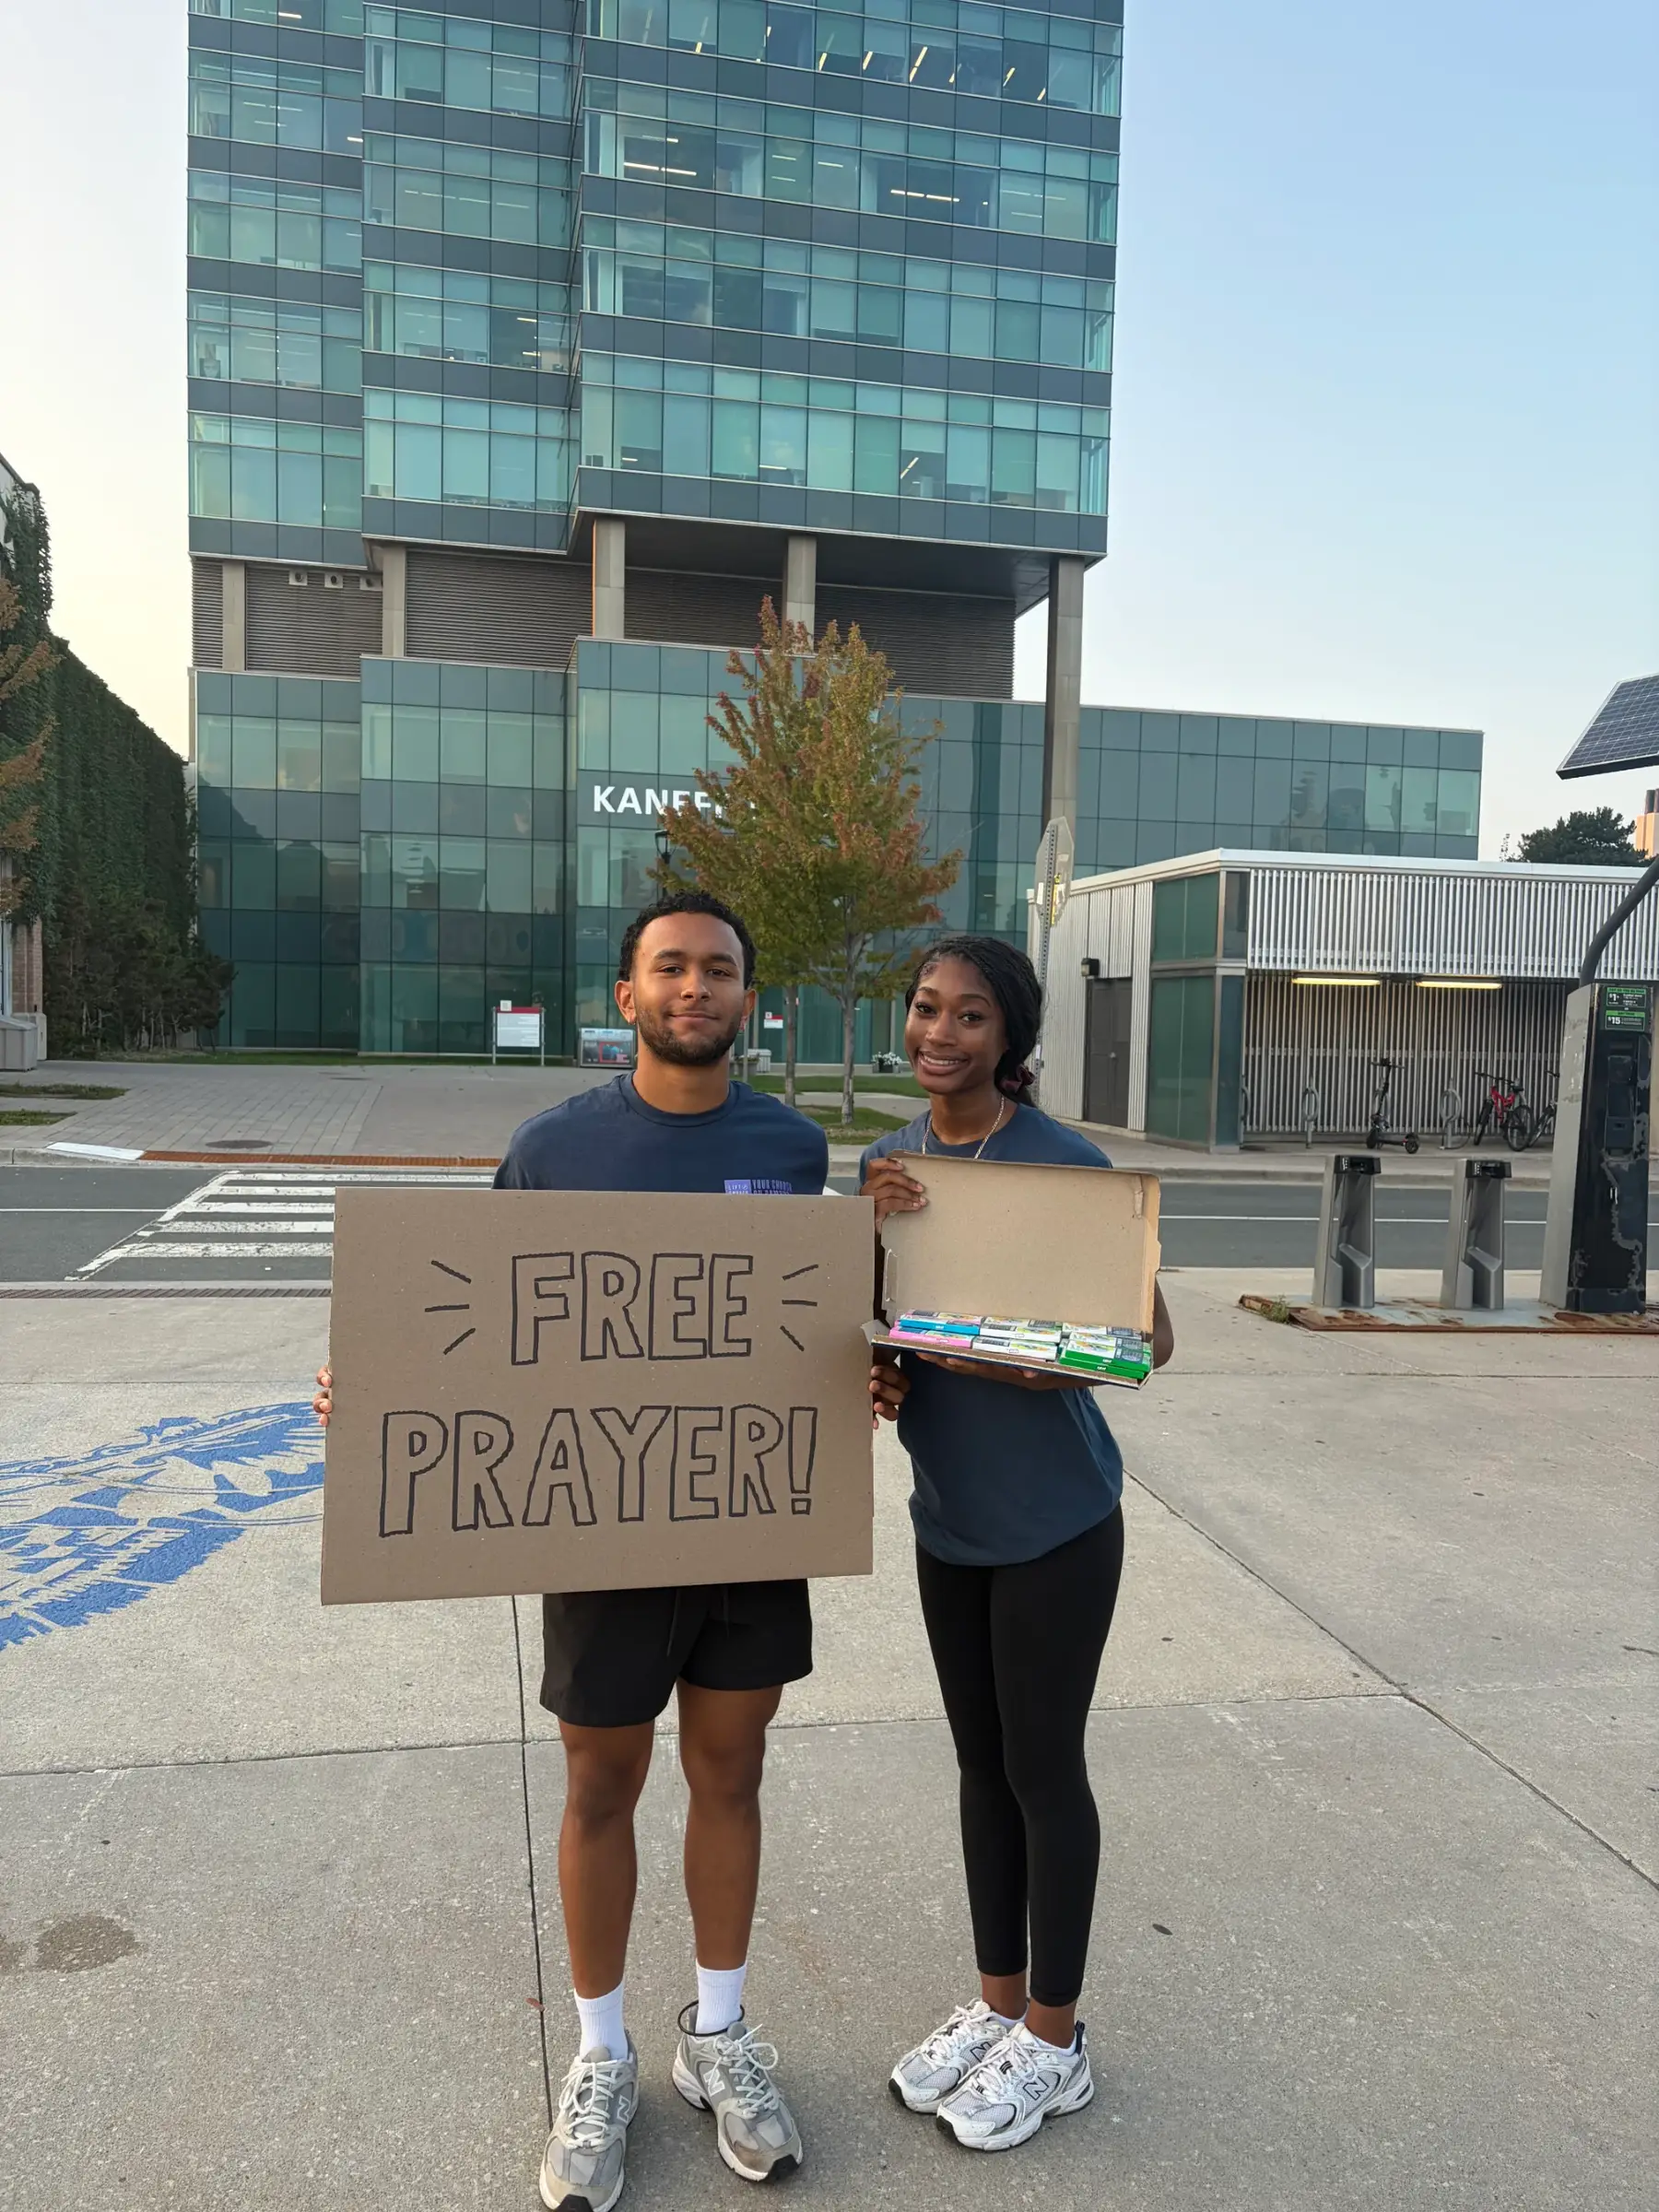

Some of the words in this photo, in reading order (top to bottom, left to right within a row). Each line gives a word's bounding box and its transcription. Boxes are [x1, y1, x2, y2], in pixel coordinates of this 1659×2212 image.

[511, 1251, 753, 1365] FREE
[379, 1403, 818, 1537] PRAYER!
[1023, 2076, 1049, 2100] N
